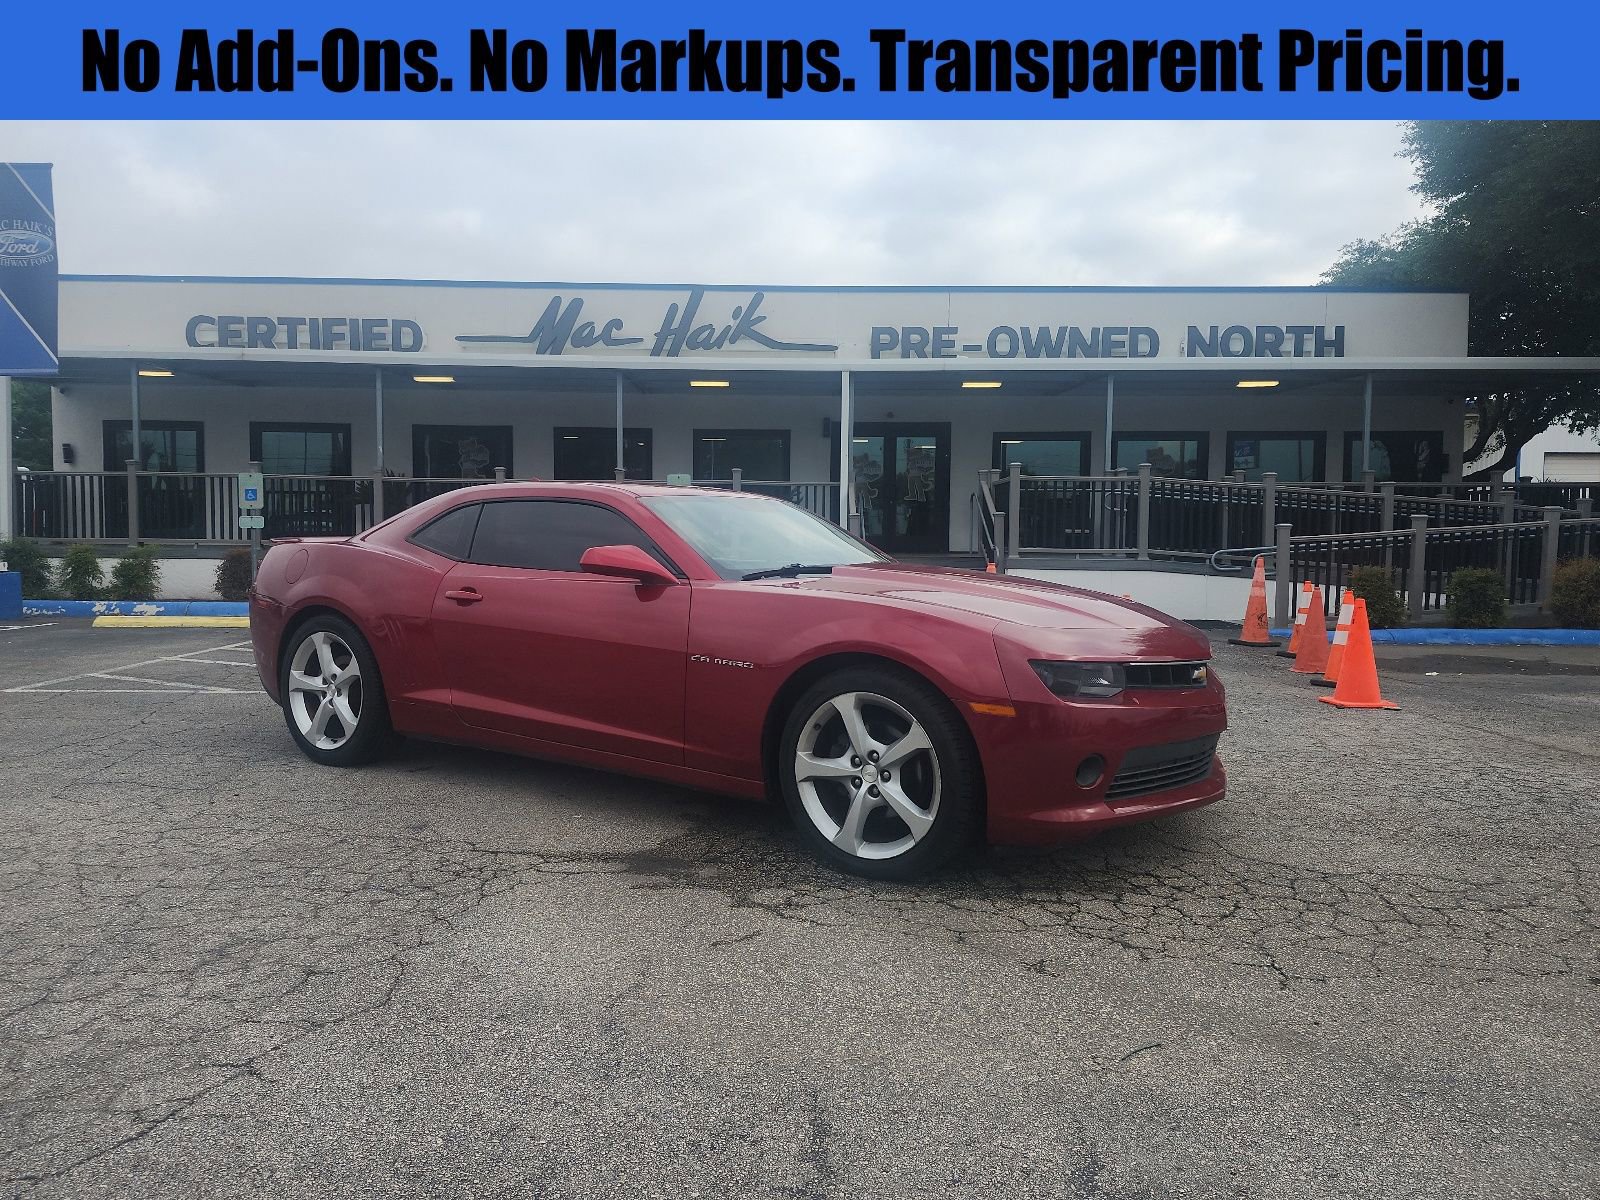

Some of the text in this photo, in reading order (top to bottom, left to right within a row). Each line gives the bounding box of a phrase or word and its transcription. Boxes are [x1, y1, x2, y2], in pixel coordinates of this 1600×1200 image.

[30, 254, 54, 266] FORD
[185, 314, 424, 353] CERTIFIED
[454, 286, 839, 357] Mac Haik
[870, 325, 1346, 360] PRE-OWNED NORTH
